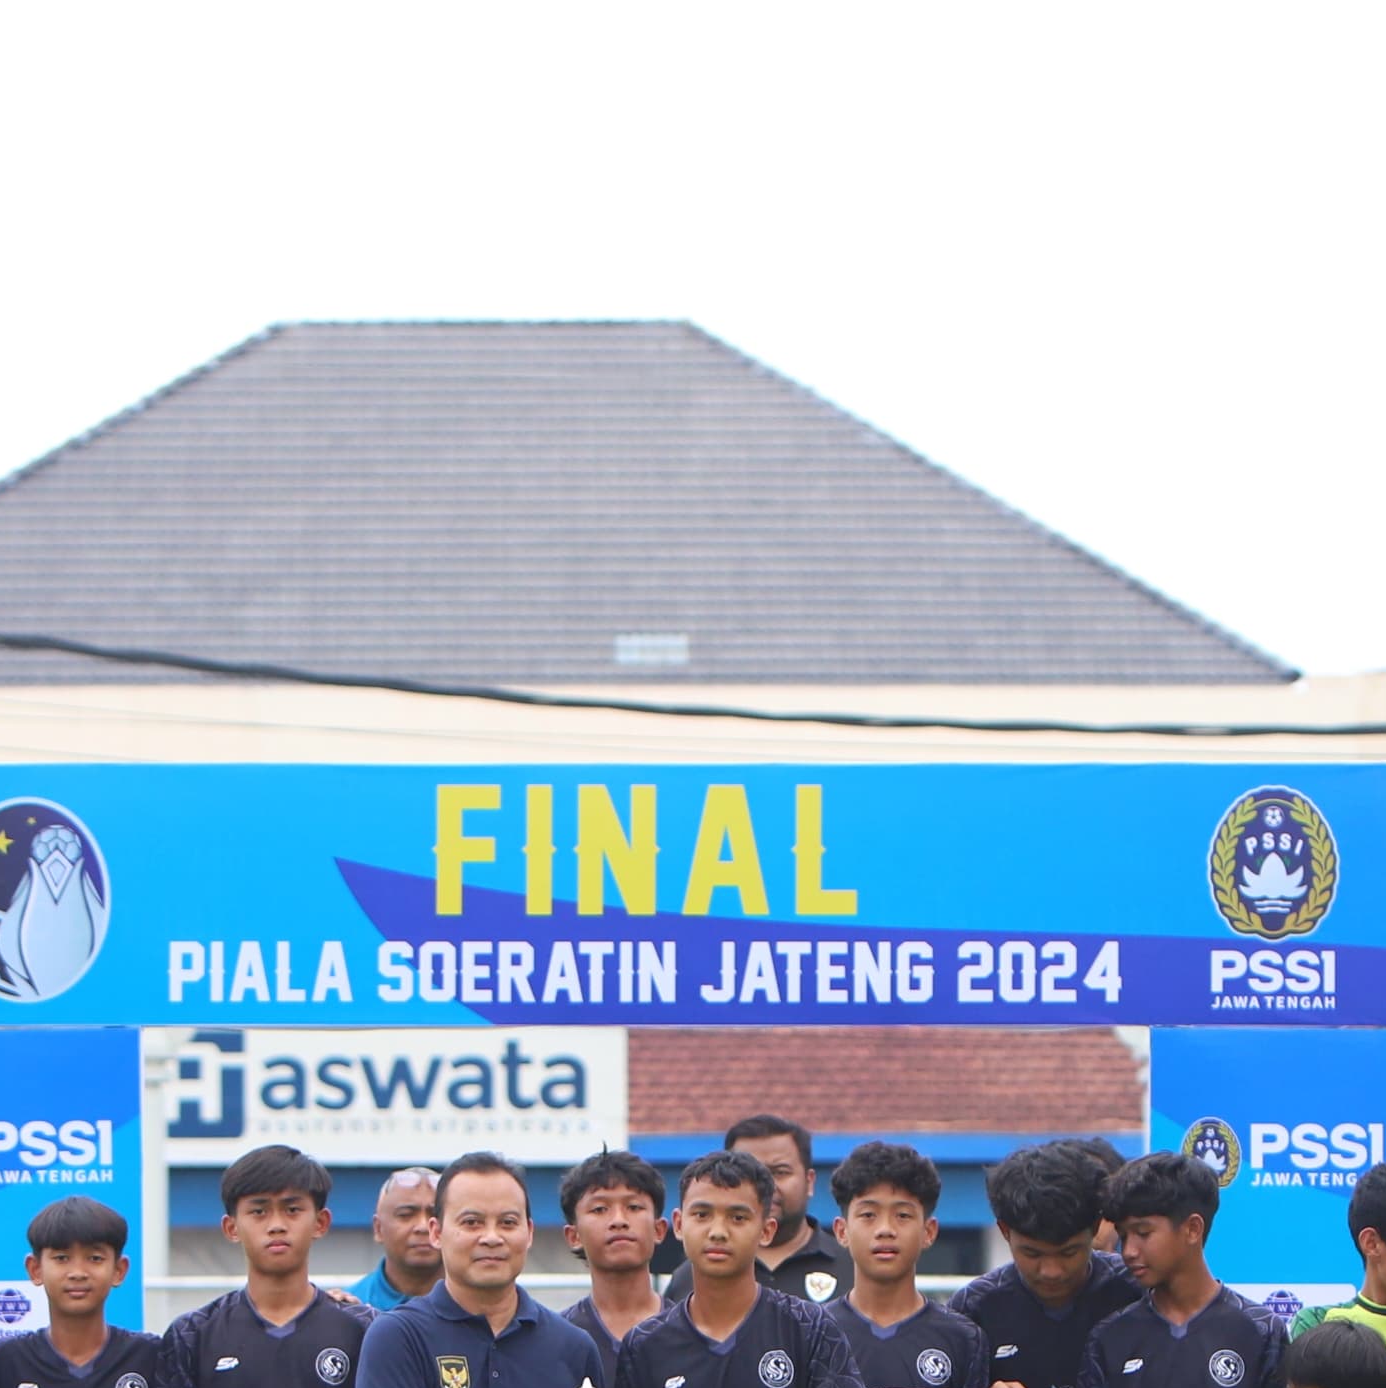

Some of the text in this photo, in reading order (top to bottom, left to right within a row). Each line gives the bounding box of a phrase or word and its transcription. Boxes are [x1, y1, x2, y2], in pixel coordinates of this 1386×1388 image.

[433, 784, 857, 916] FINAL
[1245, 832, 1304, 857] PSSI
[168, 941, 1123, 1002] PIALA SOERATIN JATENG 2024
[1210, 950, 1336, 993] PSSI
[1211, 995, 1336, 1010] JAWA TENGAH
[259, 1038, 589, 1111] aswata
[1250, 1123, 1384, 1169] PSSI
[37, 1169, 113, 1183] TENGAH
[1251, 1172, 1357, 1186] JAWA TENG
